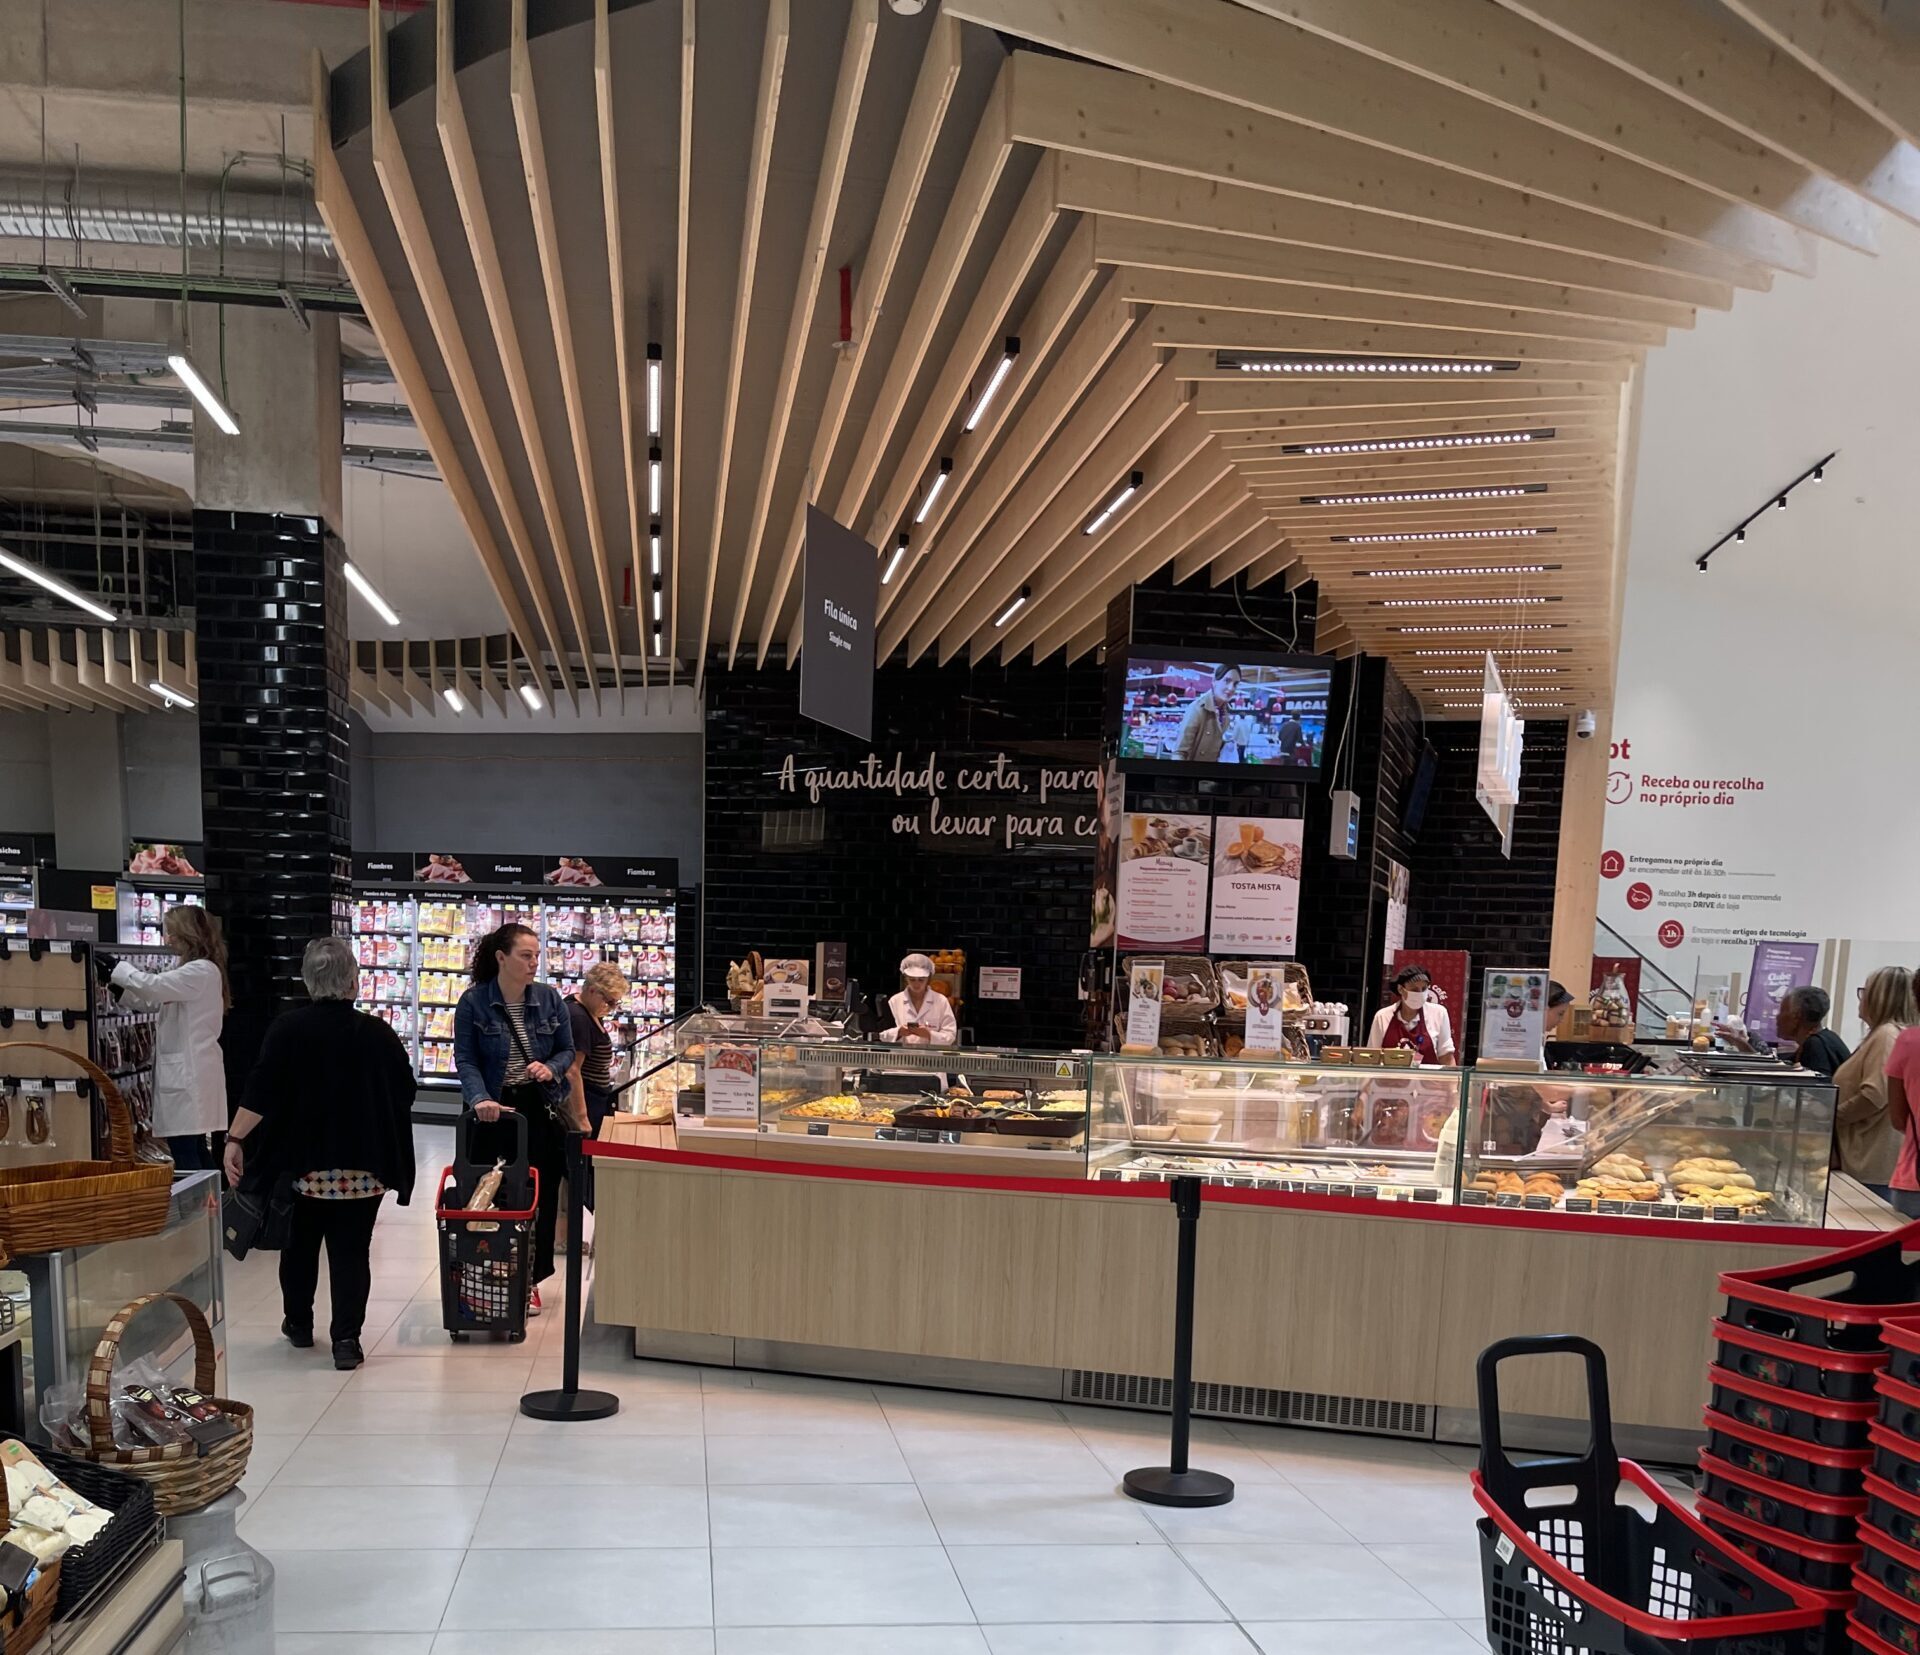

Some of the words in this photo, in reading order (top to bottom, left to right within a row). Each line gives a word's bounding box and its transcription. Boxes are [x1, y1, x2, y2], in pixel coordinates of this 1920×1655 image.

[824, 599, 838, 620] Fila
[838, 606, 857, 631] única
[829, 631, 843, 647] Single
[779, 753, 796, 793] A
[804, 751, 948, 804] quantidade
[957, 752, 1029, 793] certa,
[1040, 768, 1101, 804] para
[1641, 774, 1690, 789] Receba
[1692, 778, 1711, 790] ou
[1712, 777, 1765, 791] recolha
[1640, 792, 1657, 804] no
[1660, 791, 1711, 808] próprio
[1713, 792, 1735, 805] dia
[892, 814, 920, 835] ou
[930, 796, 997, 837] levar
[1005, 813, 1064, 849] para
[367, 862, 394, 871] Fiambres
[1629, 855, 1673, 866] Entregamos
[1684, 857, 1710, 867] próprio
[1711, 858, 1723, 867] dia
[495, 865, 522, 873] Fiambres
[627, 868, 656, 876] Fiambres
[1637, 866, 1680, 875] encomendar
[1681, 867, 1692, 875] até
[1231, 882, 1256, 890] TOSTA
[1257, 883, 1282, 891] MISTA
[1658, 889, 1687, 898] Recolha
[1687, 890, 1697, 899] 3h
[1697, 891, 1721, 900] depois
[1741, 893, 1782, 902] encomenda
[1668, 901, 1692, 909] espaço
[1692, 901, 1715, 909] DRIVE
[1726, 902, 1740, 911] loja
[1666, 929, 1677, 938] 1h
[1692, 926, 1732, 935] Encomende
[1732, 928, 1758, 937] artigos
[1758, 928, 1768, 936] de
[1769, 929, 1807, 939] tecnologia
[1720, 937, 1748, 946] recolha
